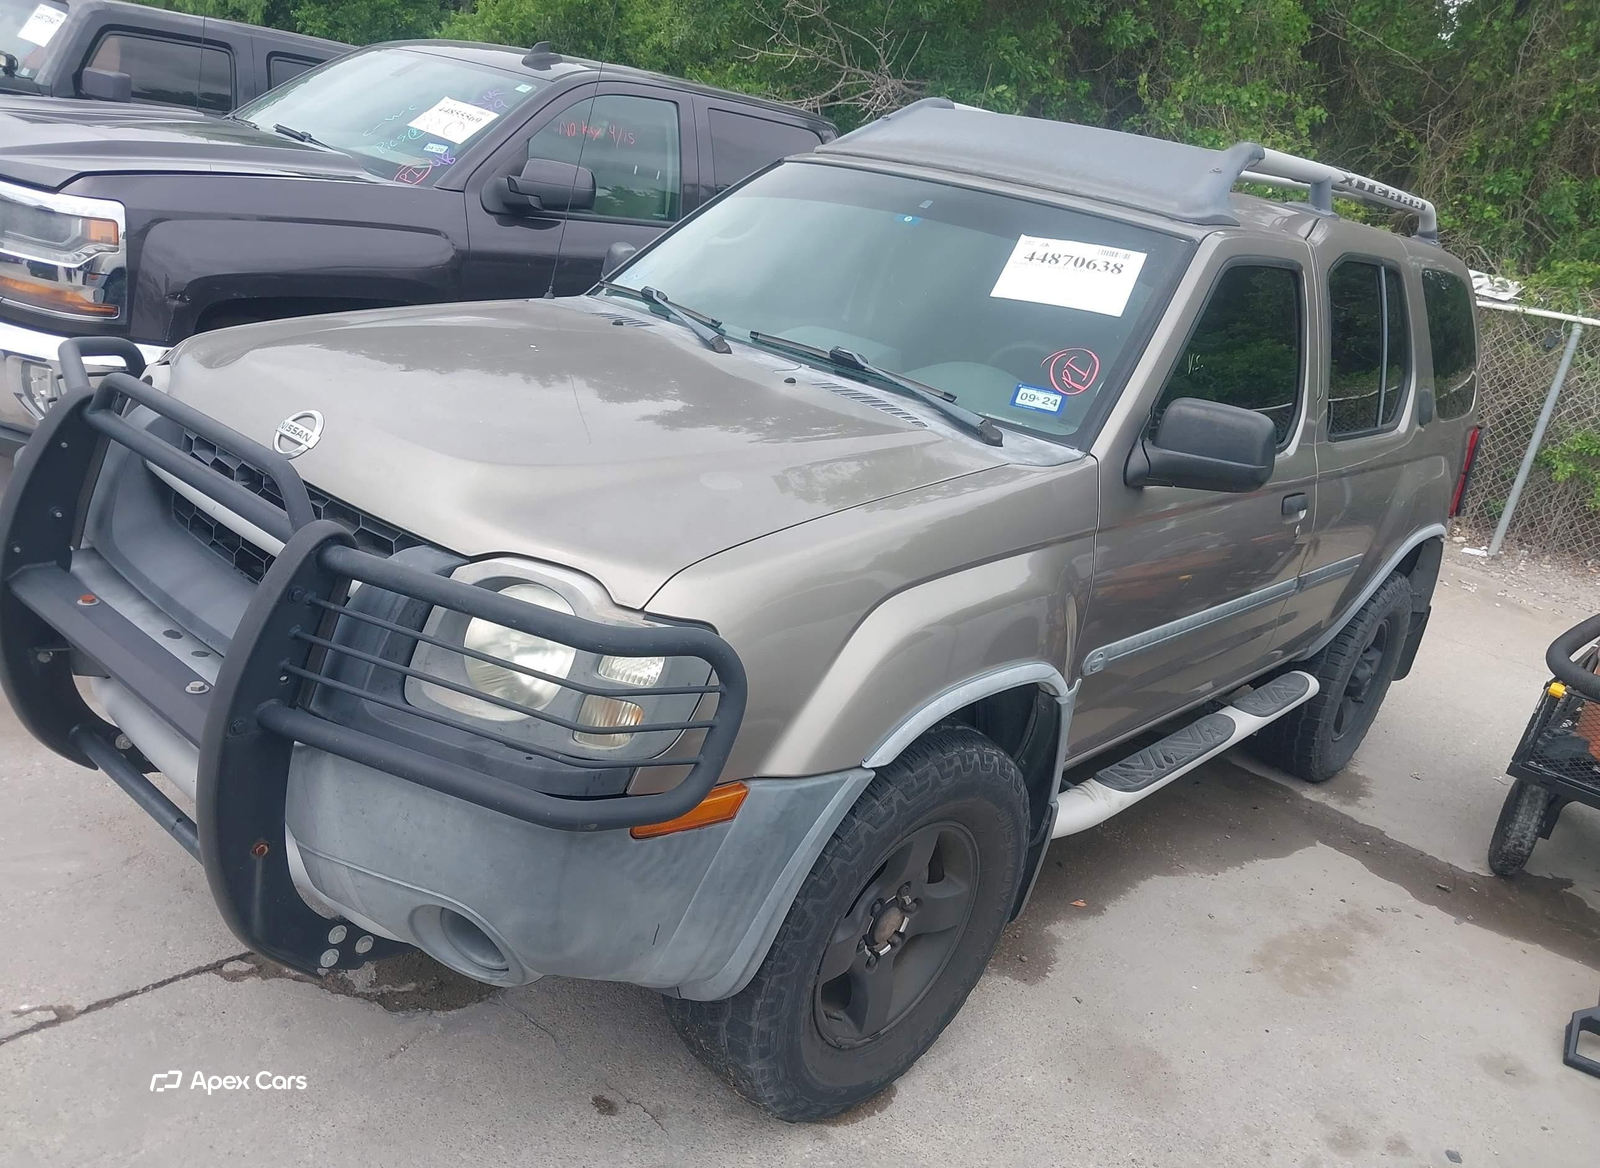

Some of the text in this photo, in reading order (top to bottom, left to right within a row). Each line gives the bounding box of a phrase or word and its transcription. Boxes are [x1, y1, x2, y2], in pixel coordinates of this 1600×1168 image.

[1339, 172, 1427, 211] XTERRA
[1023, 250, 1125, 276] 44870638
[281, 421, 313, 443] NISSAN
